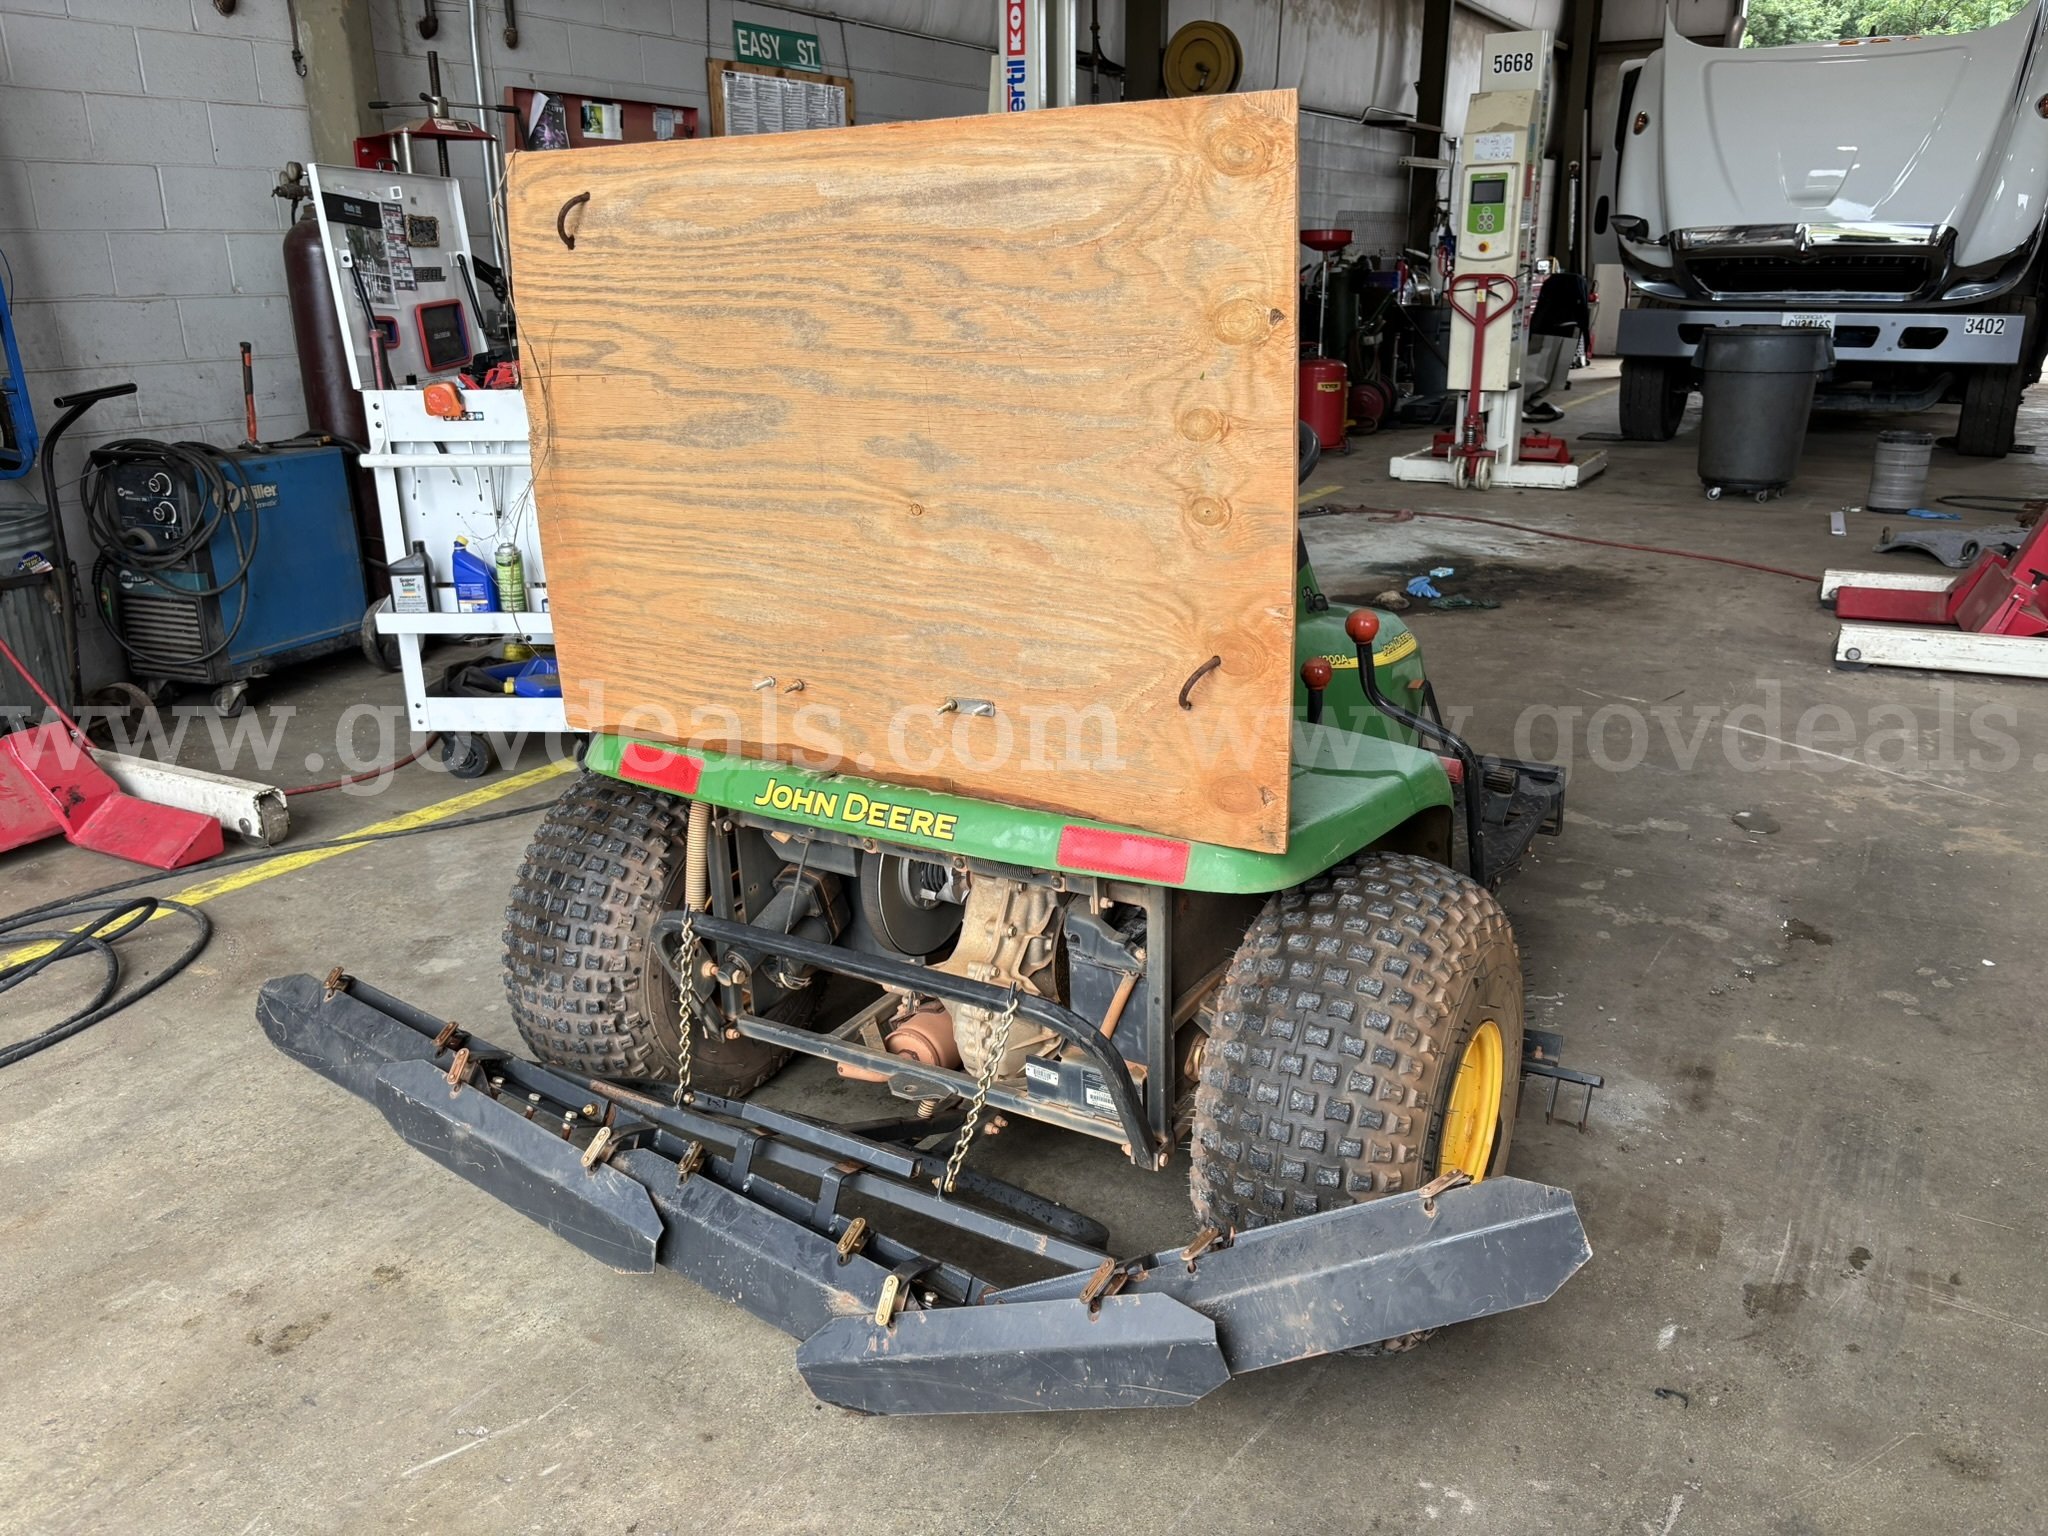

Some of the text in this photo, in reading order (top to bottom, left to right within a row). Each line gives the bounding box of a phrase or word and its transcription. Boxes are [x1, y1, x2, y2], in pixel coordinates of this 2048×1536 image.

[1010, 0, 1022, 51] KO
[737, 29, 816, 66] EASY ST
[1493, 53, 1534, 74] 5668
[1965, 318, 2005, 335] 3402
[754, 778, 959, 841] JOHN DEERE
